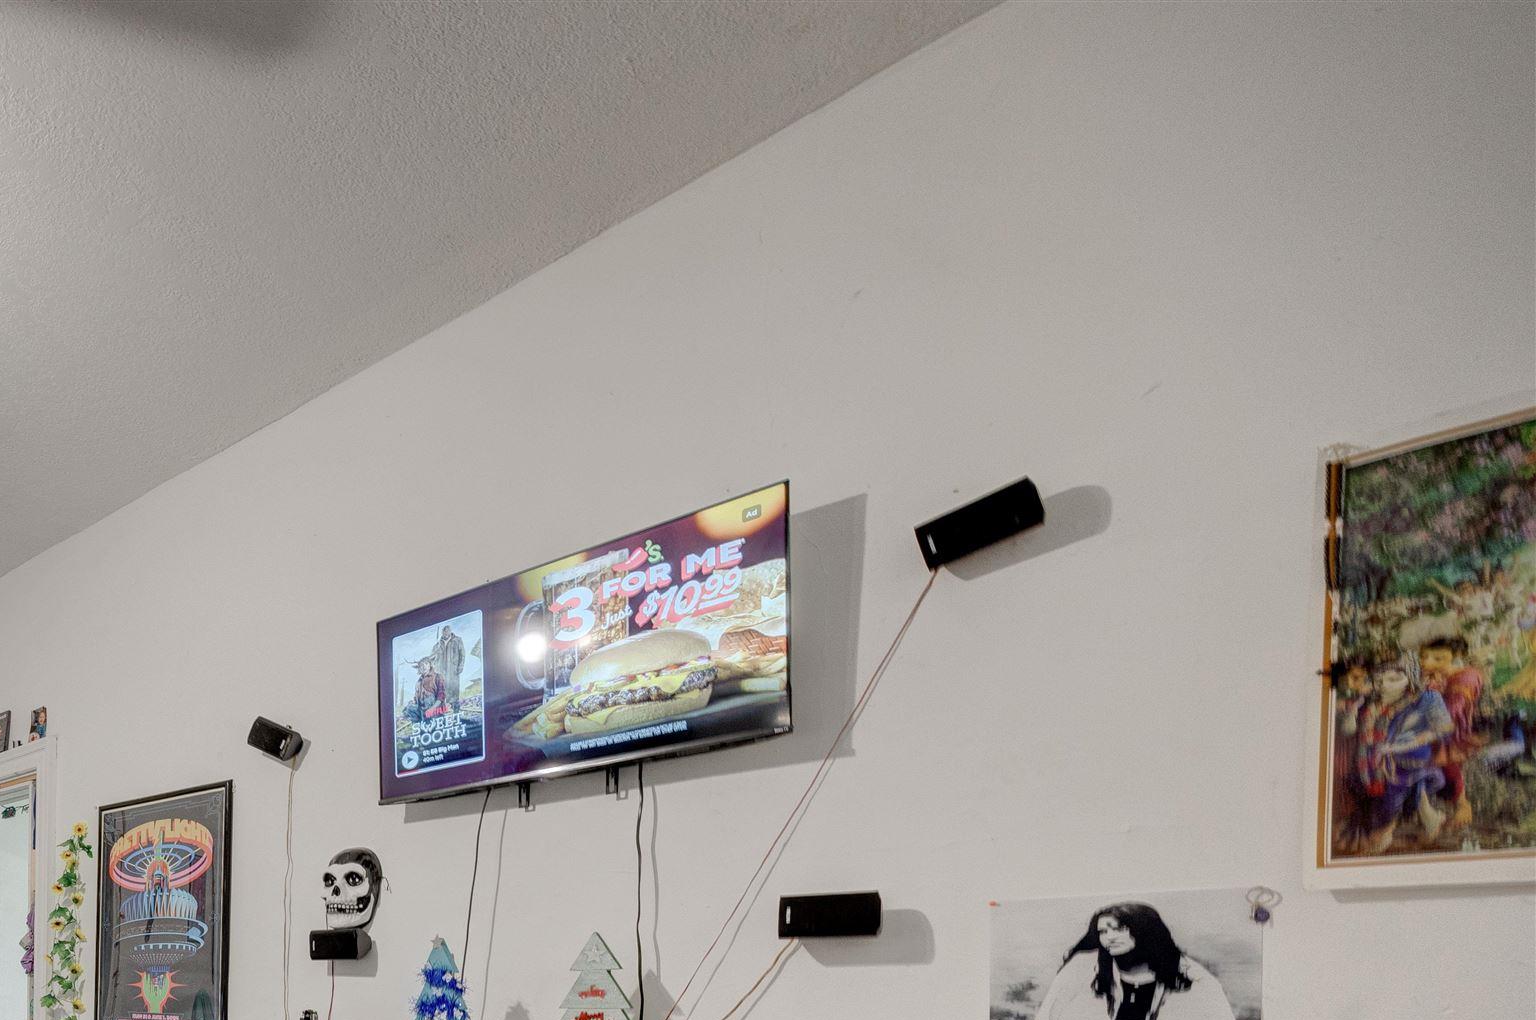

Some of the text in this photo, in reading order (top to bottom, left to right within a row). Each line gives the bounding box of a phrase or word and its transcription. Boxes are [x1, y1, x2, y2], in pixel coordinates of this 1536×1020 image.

[746, 508, 758, 518] Ad
[554, 540, 743, 642] 3 FOR ME
[411, 711, 465, 735] SWEET
[410, 724, 467, 748] TOOTH
